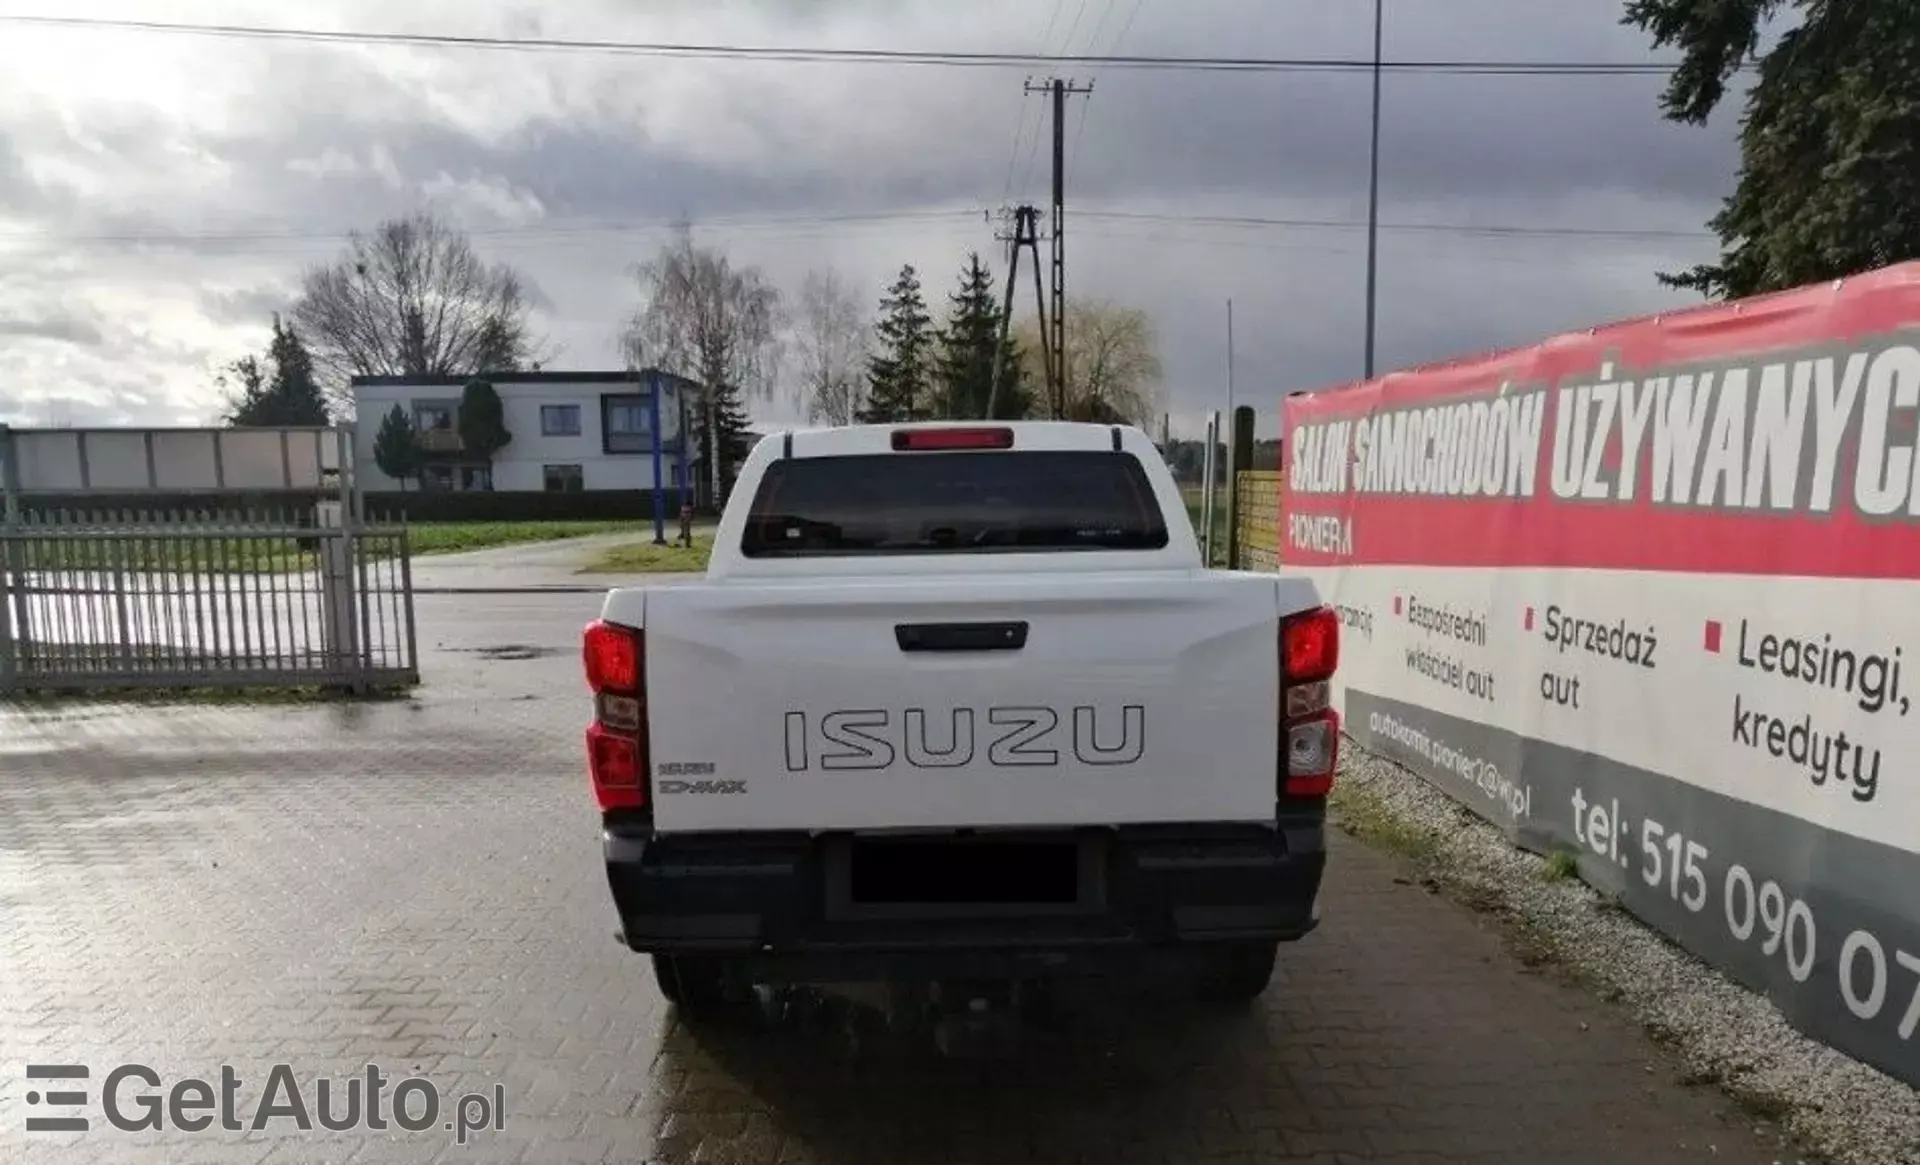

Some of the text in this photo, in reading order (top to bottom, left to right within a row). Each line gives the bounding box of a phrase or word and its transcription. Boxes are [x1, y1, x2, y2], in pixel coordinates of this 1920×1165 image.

[1290, 346, 1920, 516] SALON SAMOCHODÓW UŻYWANYC
[1544, 605, 1657, 669] Sprzedaż
[1739, 618, 1910, 717] Leasingi,
[1466, 669, 1494, 702] aut
[1541, 672, 1580, 709] aut
[785, 705, 1145, 771] ISUZU
[1732, 693, 1881, 802] kredyty
[1571, 787, 1629, 868] tel:
[1642, 818, 1708, 912] 515
[1724, 863, 1816, 982] 090
